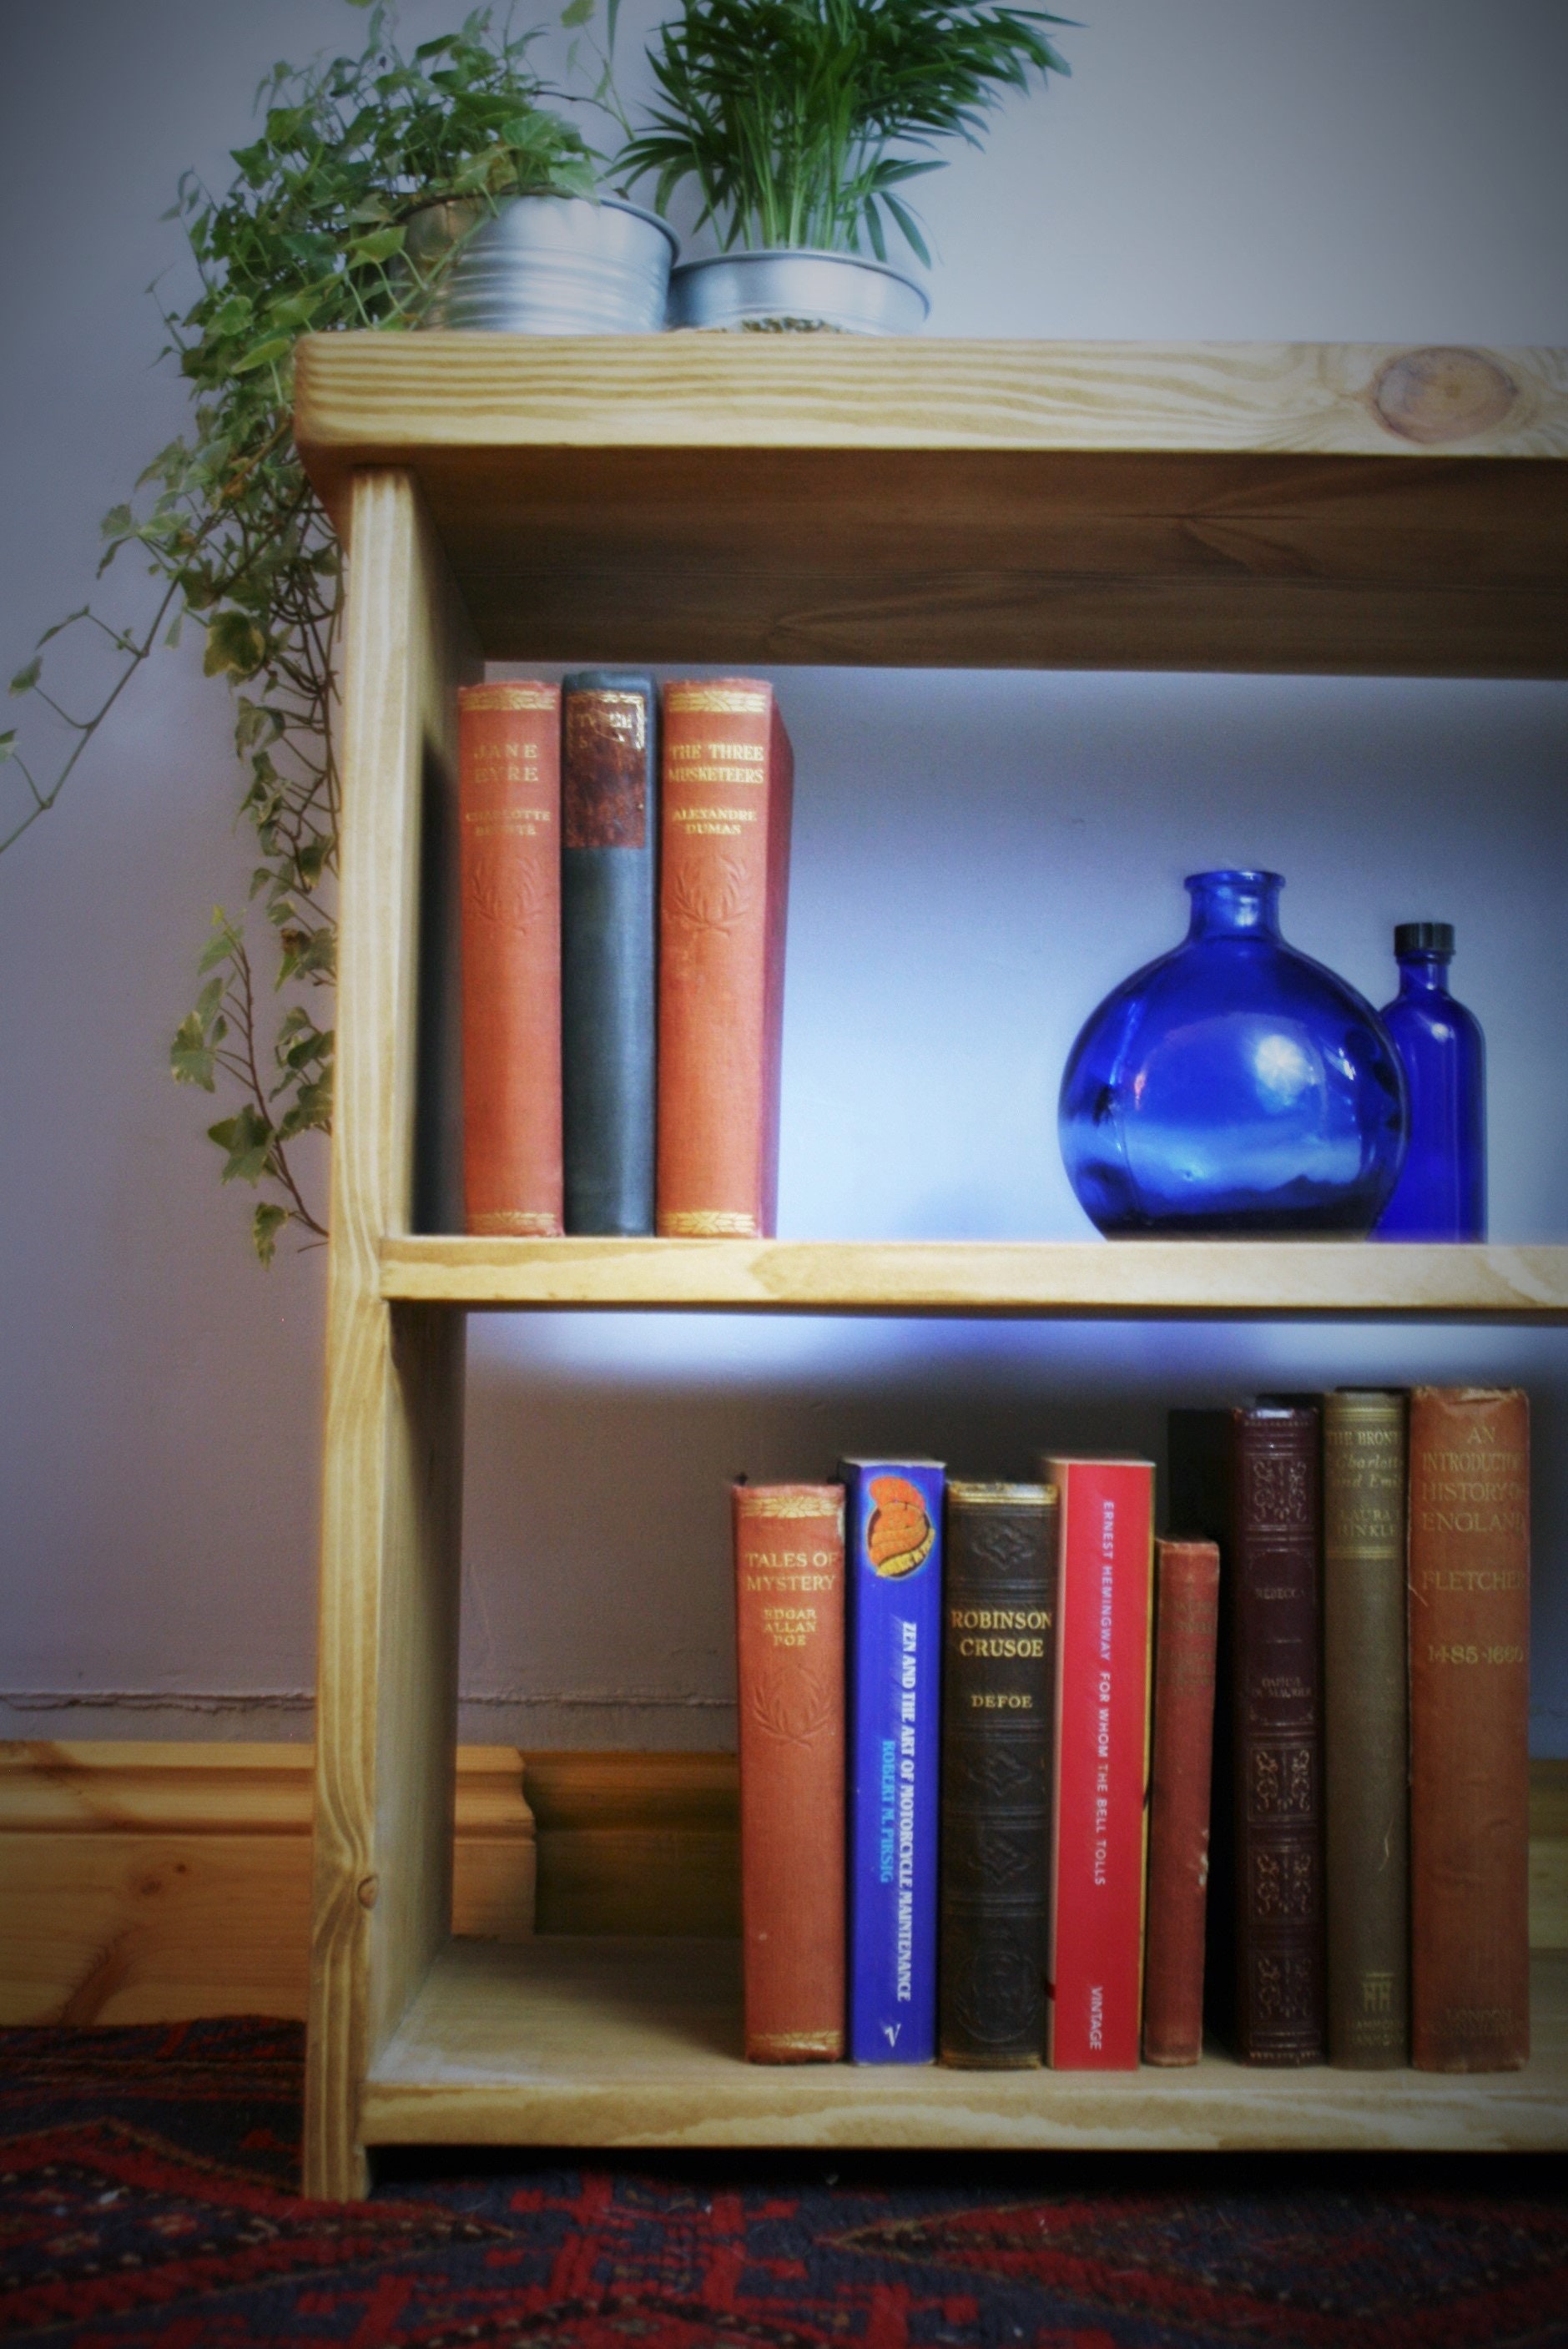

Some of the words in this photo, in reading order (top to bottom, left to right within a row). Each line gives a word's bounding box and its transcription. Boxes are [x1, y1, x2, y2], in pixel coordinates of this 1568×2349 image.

[473, 744, 538, 759] JANE
[671, 744, 702, 760] THE
[708, 744, 764, 761] THREE
[474, 767, 539, 783] EYRE
[668, 767, 764, 784] MUSKETEERS
[673, 809, 757, 822] ALEXANDRE
[685, 824, 742, 834] DUMAS
[1467, 1427, 1495, 1444] AN
[1422, 1482, 1508, 1501] HISTORY
[1102, 1501, 1115, 1559] ERNEST
[1422, 1512, 1525, 1533] ENGLAND
[747, 1553, 807, 1568] TALES
[813, 1552, 837, 1567] OF
[747, 1575, 836, 1592] MYSTERY
[1422, 1570, 1525, 1590] FLETCHER
[764, 1609, 817, 1621] EDGAR
[950, 1611, 1051, 1630] ROBINSON
[1100, 1565, 1113, 1661] HEMINGWAY
[764, 1622, 817, 1635] ALLAN
[902, 1621, 917, 1652] ZEN
[773, 1636, 808, 1648] POE
[959, 1638, 1044, 1658] CRUSOE
[901, 1655, 916, 1690] AND
[1098, 1671, 1111, 1702] FOR
[900, 1691, 916, 1722] THE
[971, 1695, 1032, 1708] DEFOE
[900, 1722, 915, 1757] ART
[1097, 1708, 1110, 1758] WHOM
[881, 1741, 895, 1803] ROBERT
[900, 1759, 915, 1782] OF
[1097, 1763, 1109, 1792] THE
[881, 1807, 895, 1825] M.
[1095, 1798, 1108, 1833] BELL
[899, 1784, 915, 1888] MOTORCYCLE
[880, 1827, 894, 1883] PIRSIG
[1094, 1840, 1107, 1886] TOLLS
[897, 1891, 913, 2002] MAINTENANCE
[1089, 1986, 1104, 2050] VINTAGE
